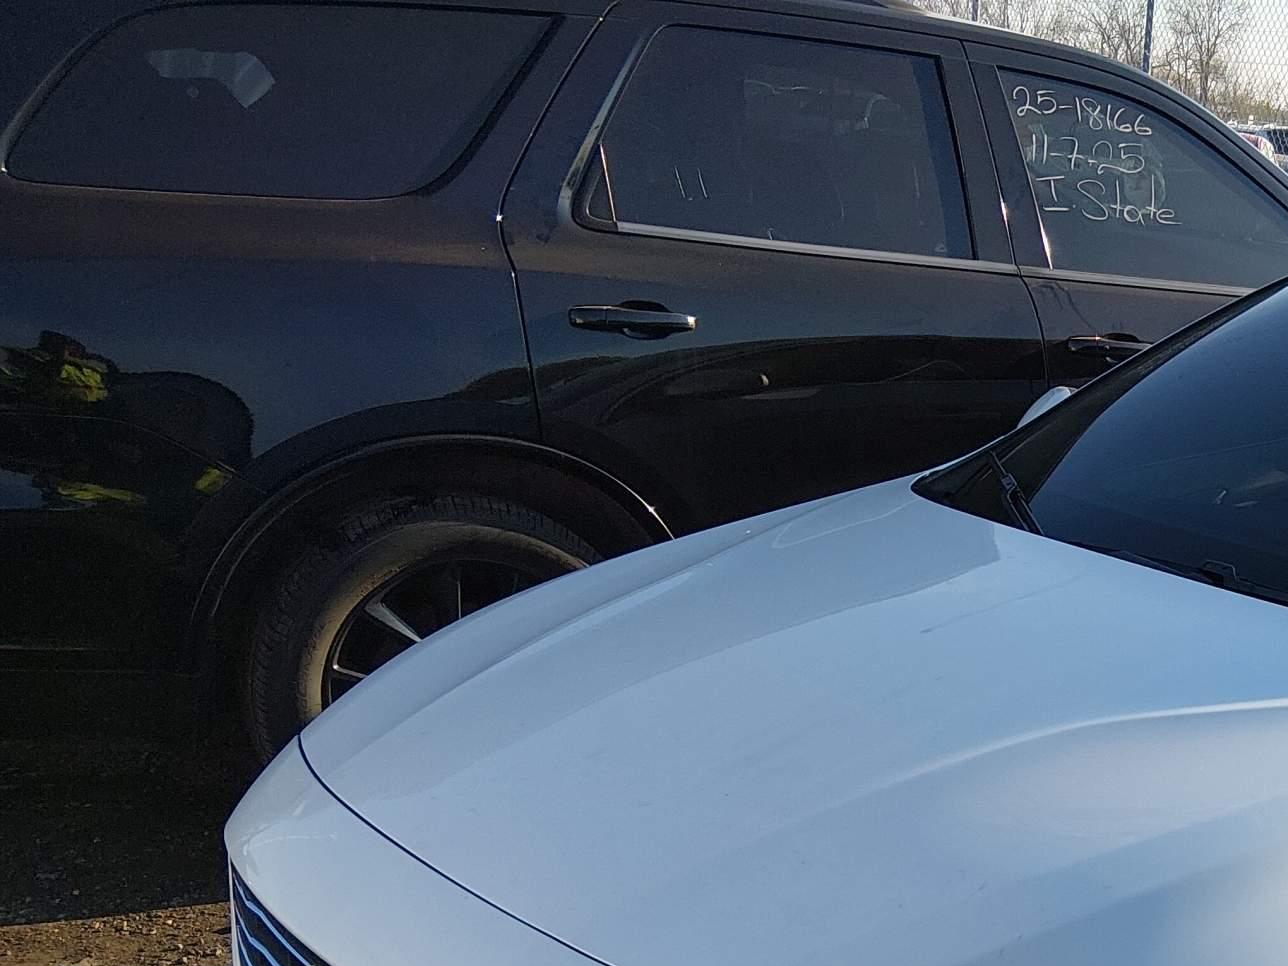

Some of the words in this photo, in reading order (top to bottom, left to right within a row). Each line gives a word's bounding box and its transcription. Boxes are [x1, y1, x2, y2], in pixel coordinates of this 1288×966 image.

[1012, 86, 1152, 136] 25-18166
[1031, 134, 1145, 175] 11-7-25
[1077, 174, 1183, 225] State
